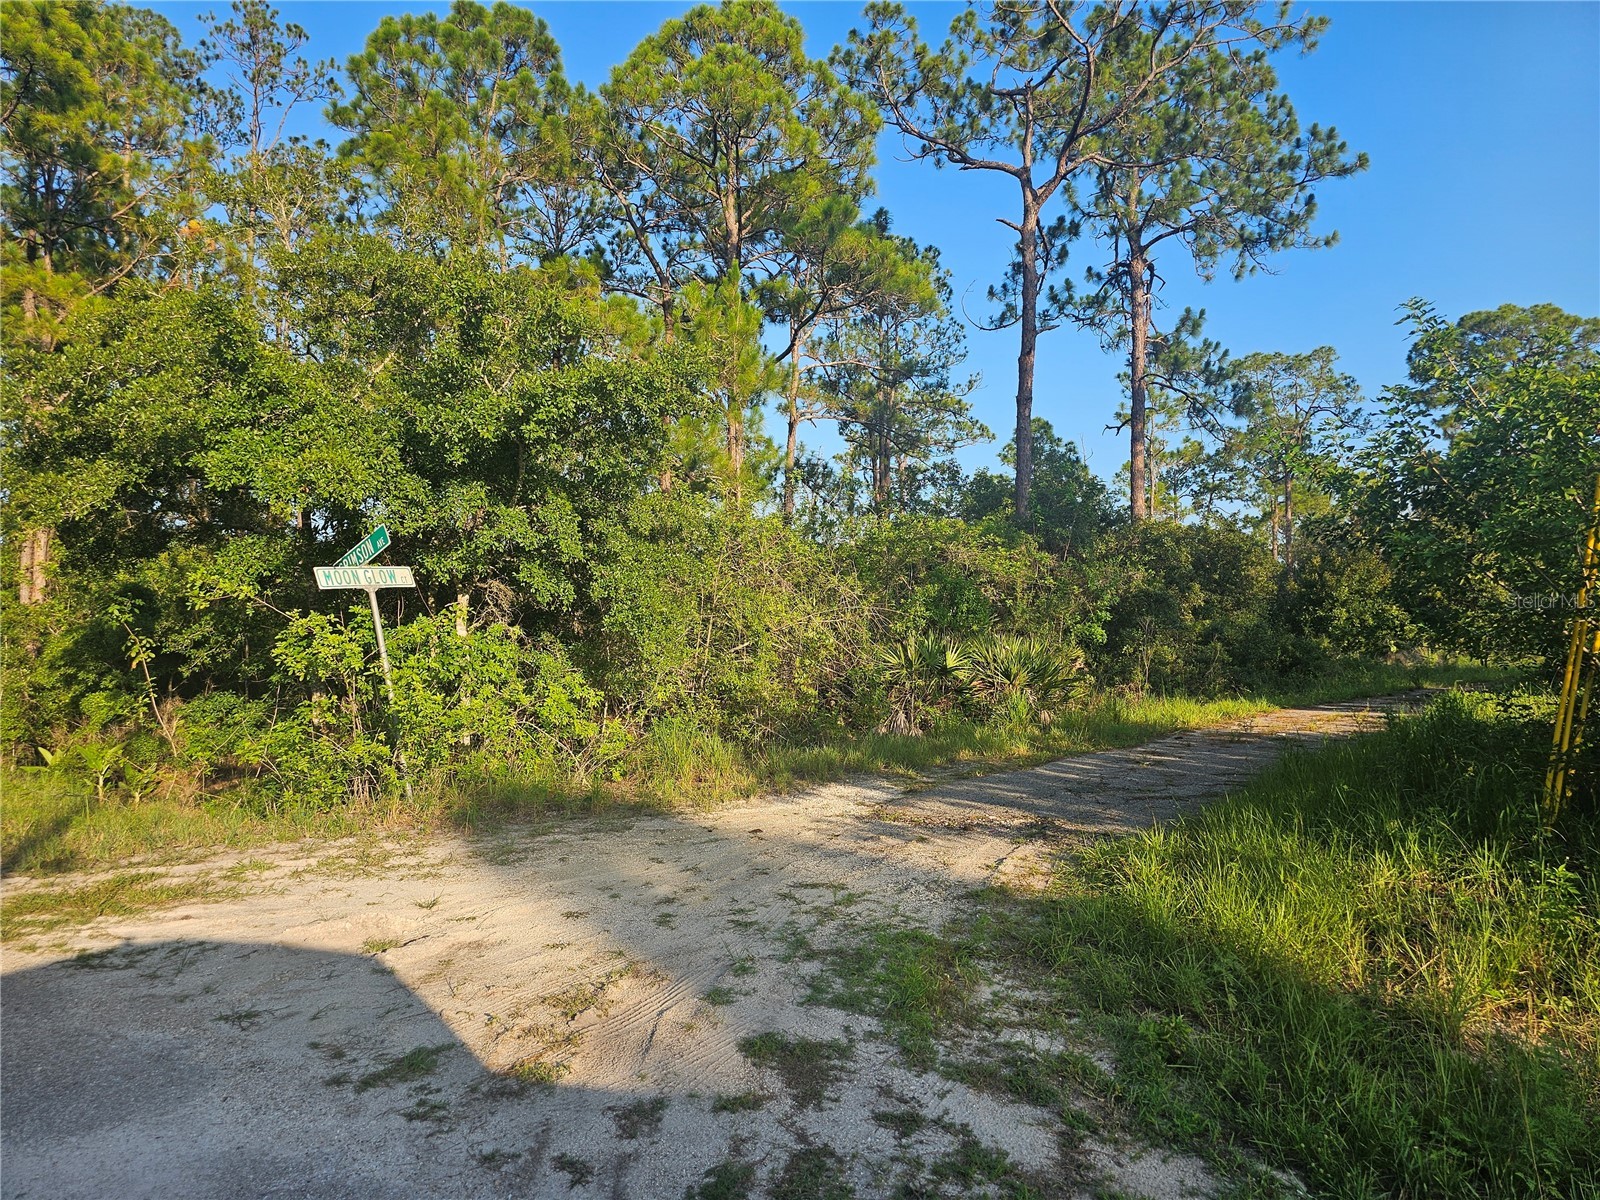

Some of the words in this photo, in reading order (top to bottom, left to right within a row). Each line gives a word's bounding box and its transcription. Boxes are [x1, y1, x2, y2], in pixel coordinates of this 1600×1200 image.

[376, 536, 386, 549] AVE
[322, 569, 361, 586] MOON
[363, 569, 397, 585] GLOW
[400, 576, 408, 584] CT
